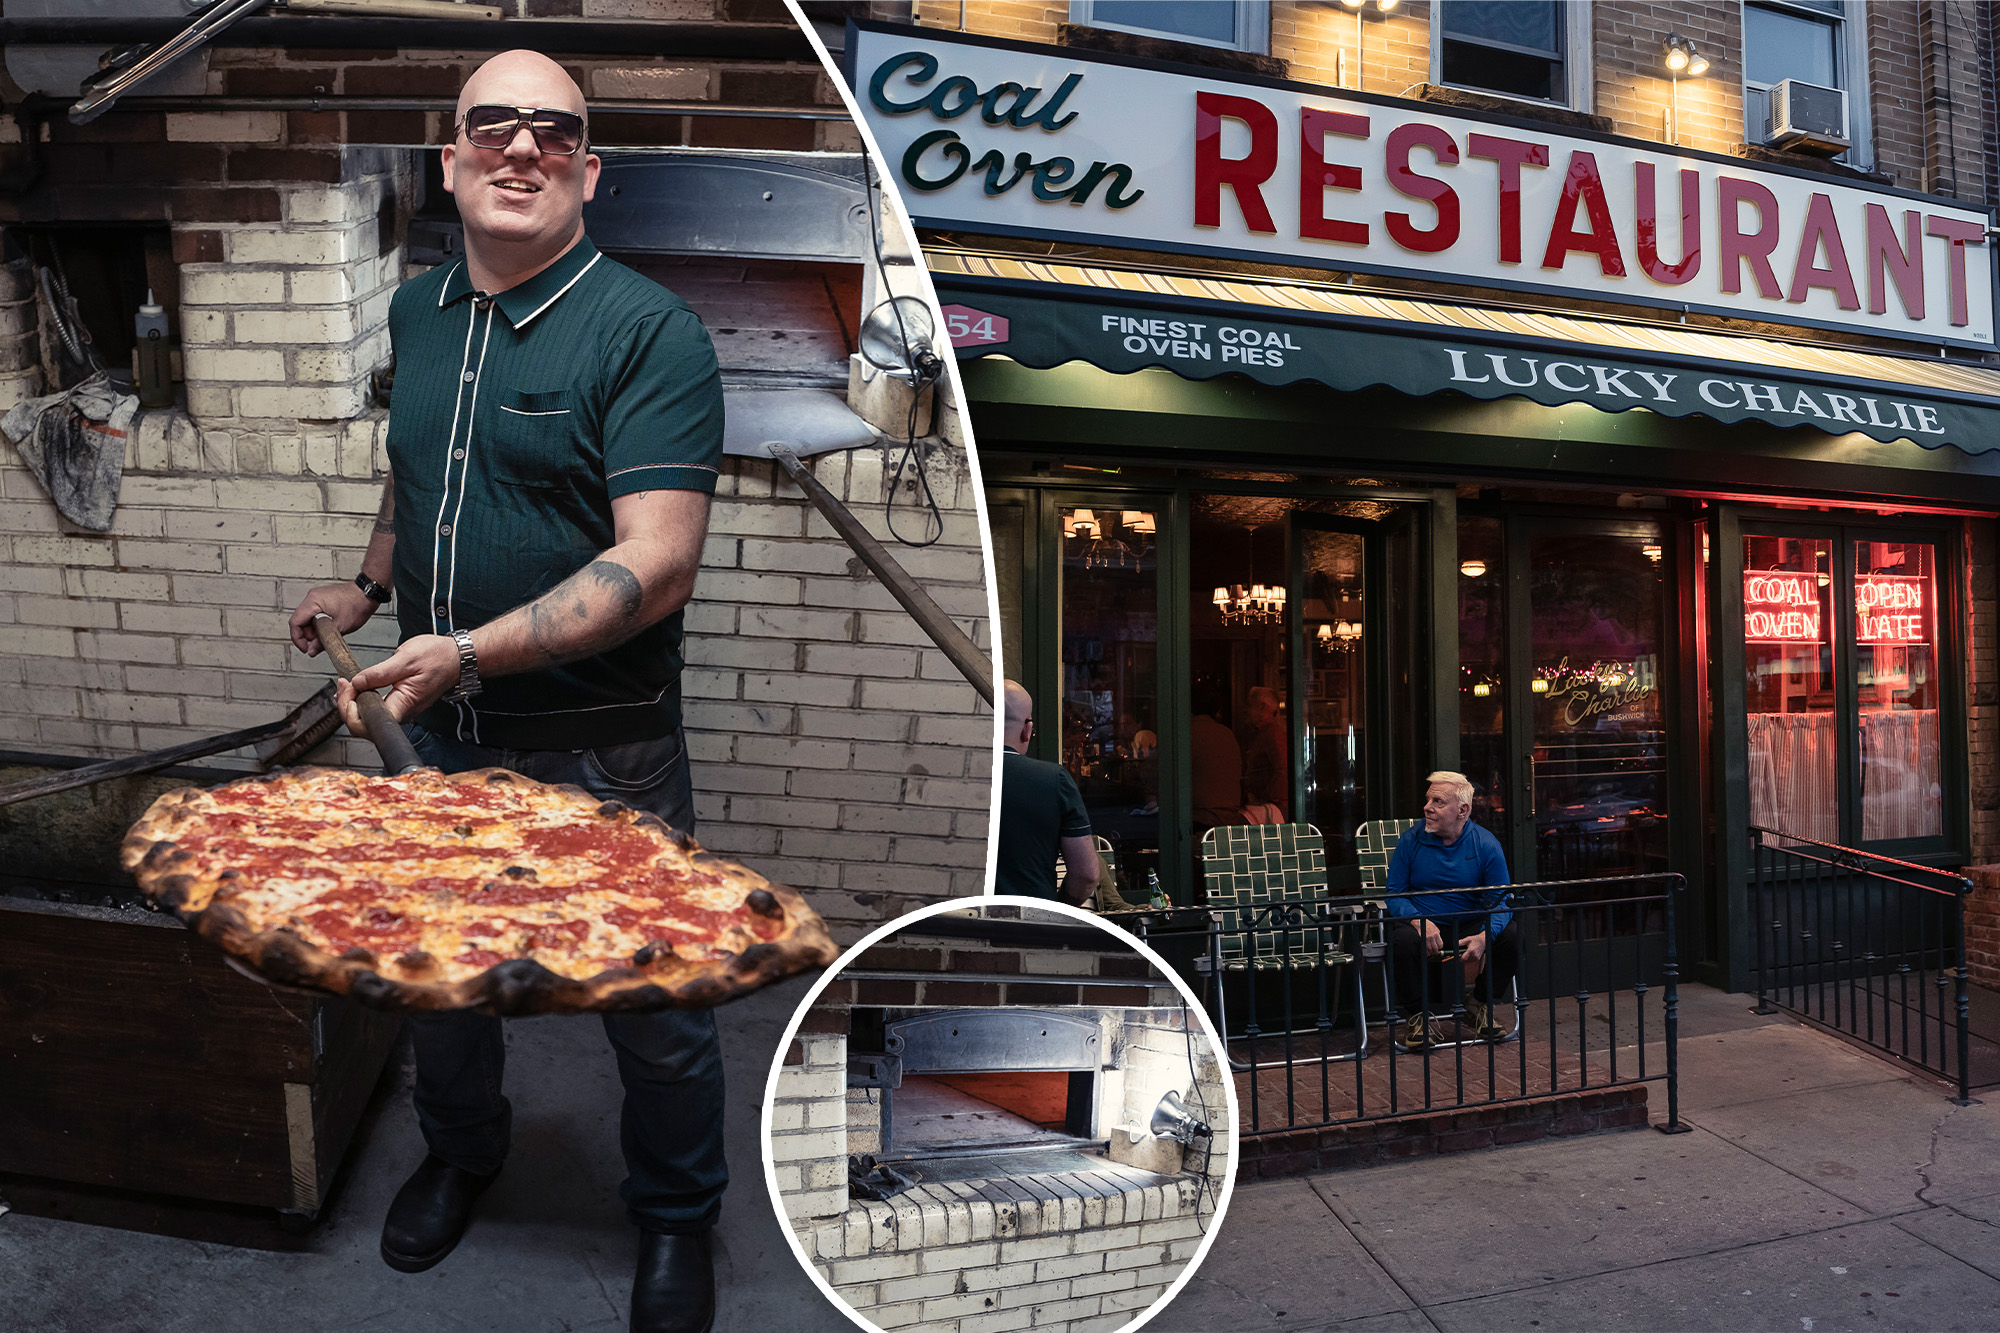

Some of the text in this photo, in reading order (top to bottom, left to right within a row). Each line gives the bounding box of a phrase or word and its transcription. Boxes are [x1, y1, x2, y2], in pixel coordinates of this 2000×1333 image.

[869, 51, 1084, 133] Coal
[902, 130, 1145, 210] Oven
[1194, 90, 1986, 327] RESTAURANT
[1102, 315, 1301, 350] FINEST COAL
[1123, 336, 1285, 367] OVEN PIES
[1444, 348, 1946, 435] LUCKY CHARLIE
[1749, 577, 1820, 605] COAL
[1860, 582, 1922, 608] OPEN
[1750, 611, 1818, 638] OVEN
[1863, 615, 1923, 639] LATE
[1564, 677, 1650, 725] Charlie
[1607, 712, 1645, 721] BUSHWICK
